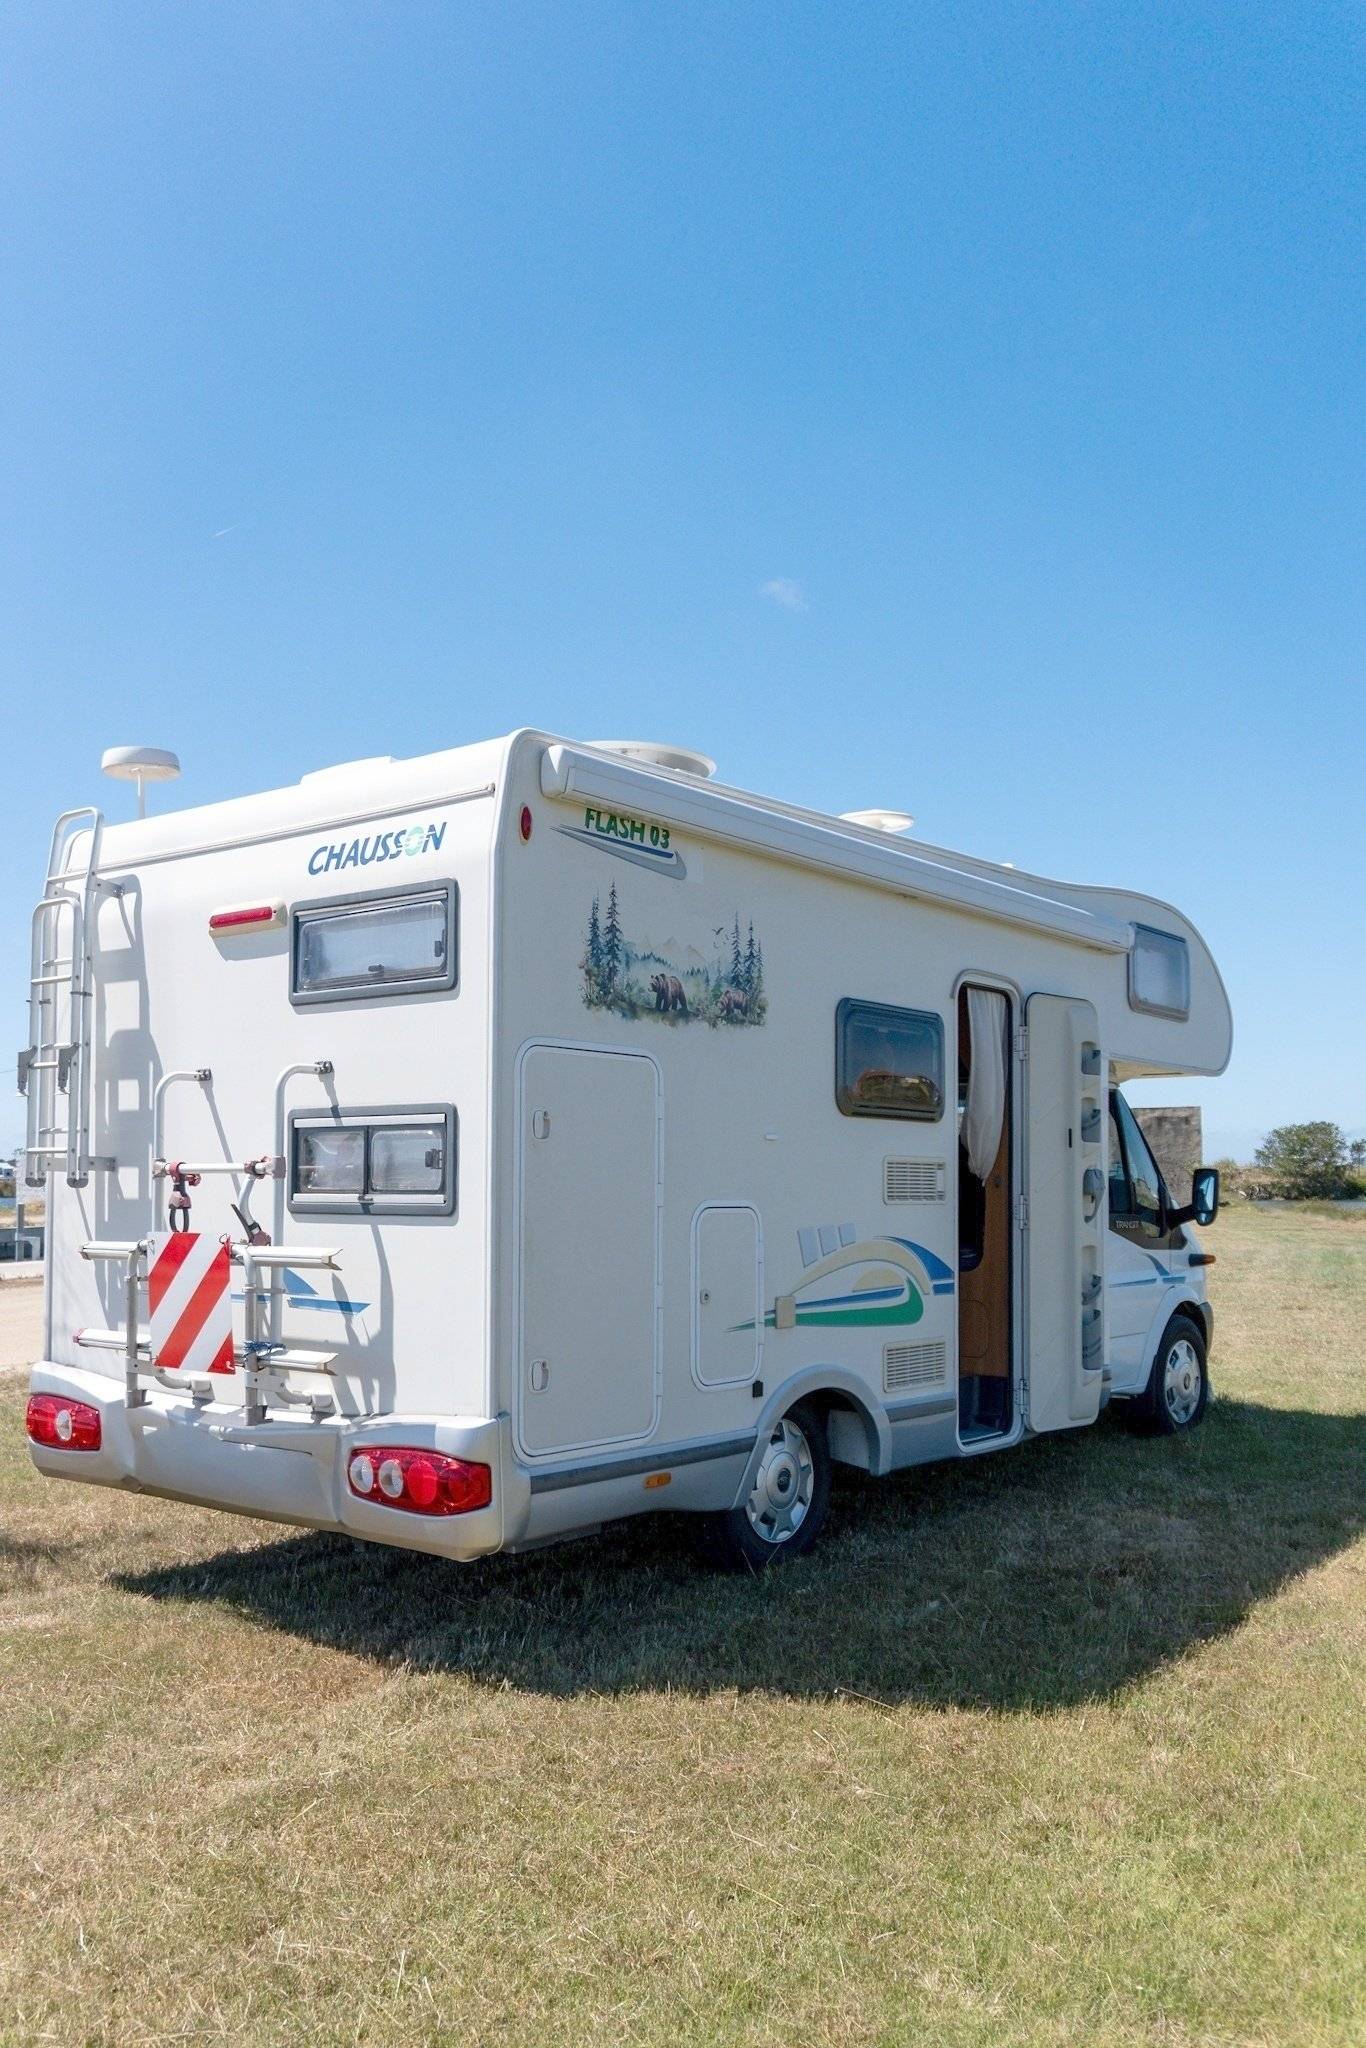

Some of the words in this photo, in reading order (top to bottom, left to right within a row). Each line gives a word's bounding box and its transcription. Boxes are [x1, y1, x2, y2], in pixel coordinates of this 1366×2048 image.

[308, 822, 447, 875] CHAUSSON
[585, 808, 645, 843] FLASH
[650, 825, 670, 849] 03
